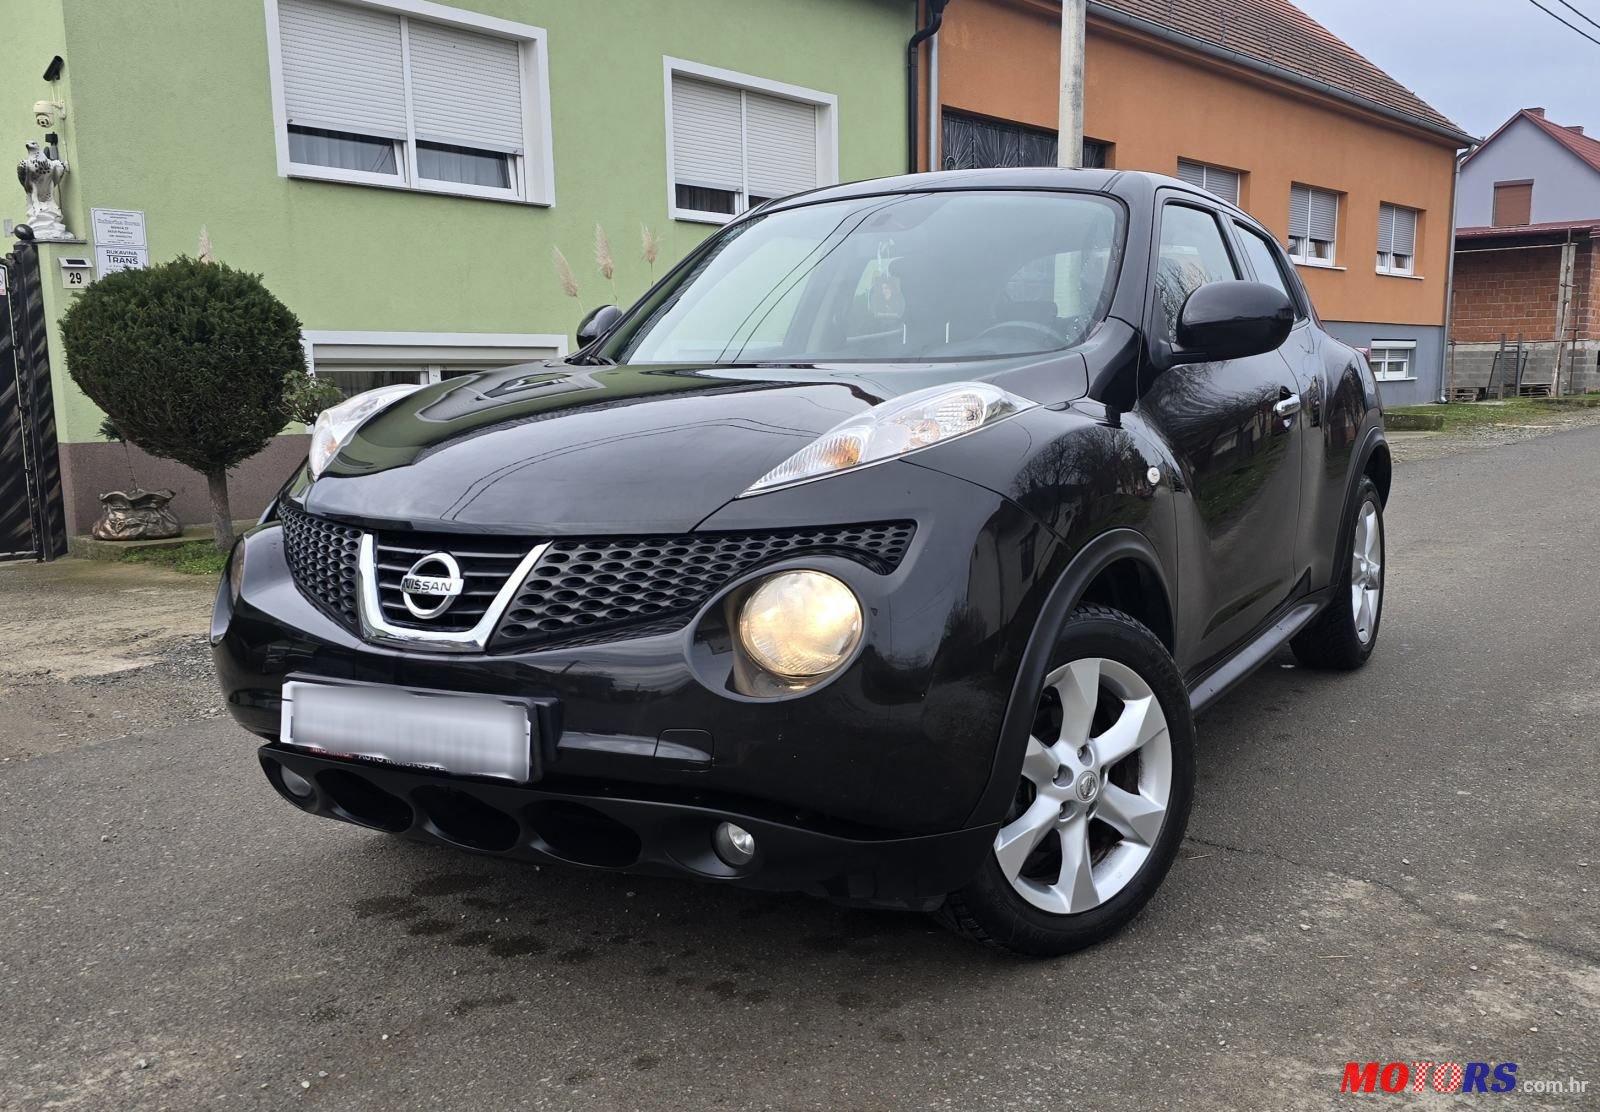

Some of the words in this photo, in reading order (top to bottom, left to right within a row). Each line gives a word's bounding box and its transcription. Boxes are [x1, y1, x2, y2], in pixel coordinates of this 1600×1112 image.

[106, 254, 139, 265] TRANS
[69, 271, 82, 285] 29
[402, 577, 452, 592] NISSAN
